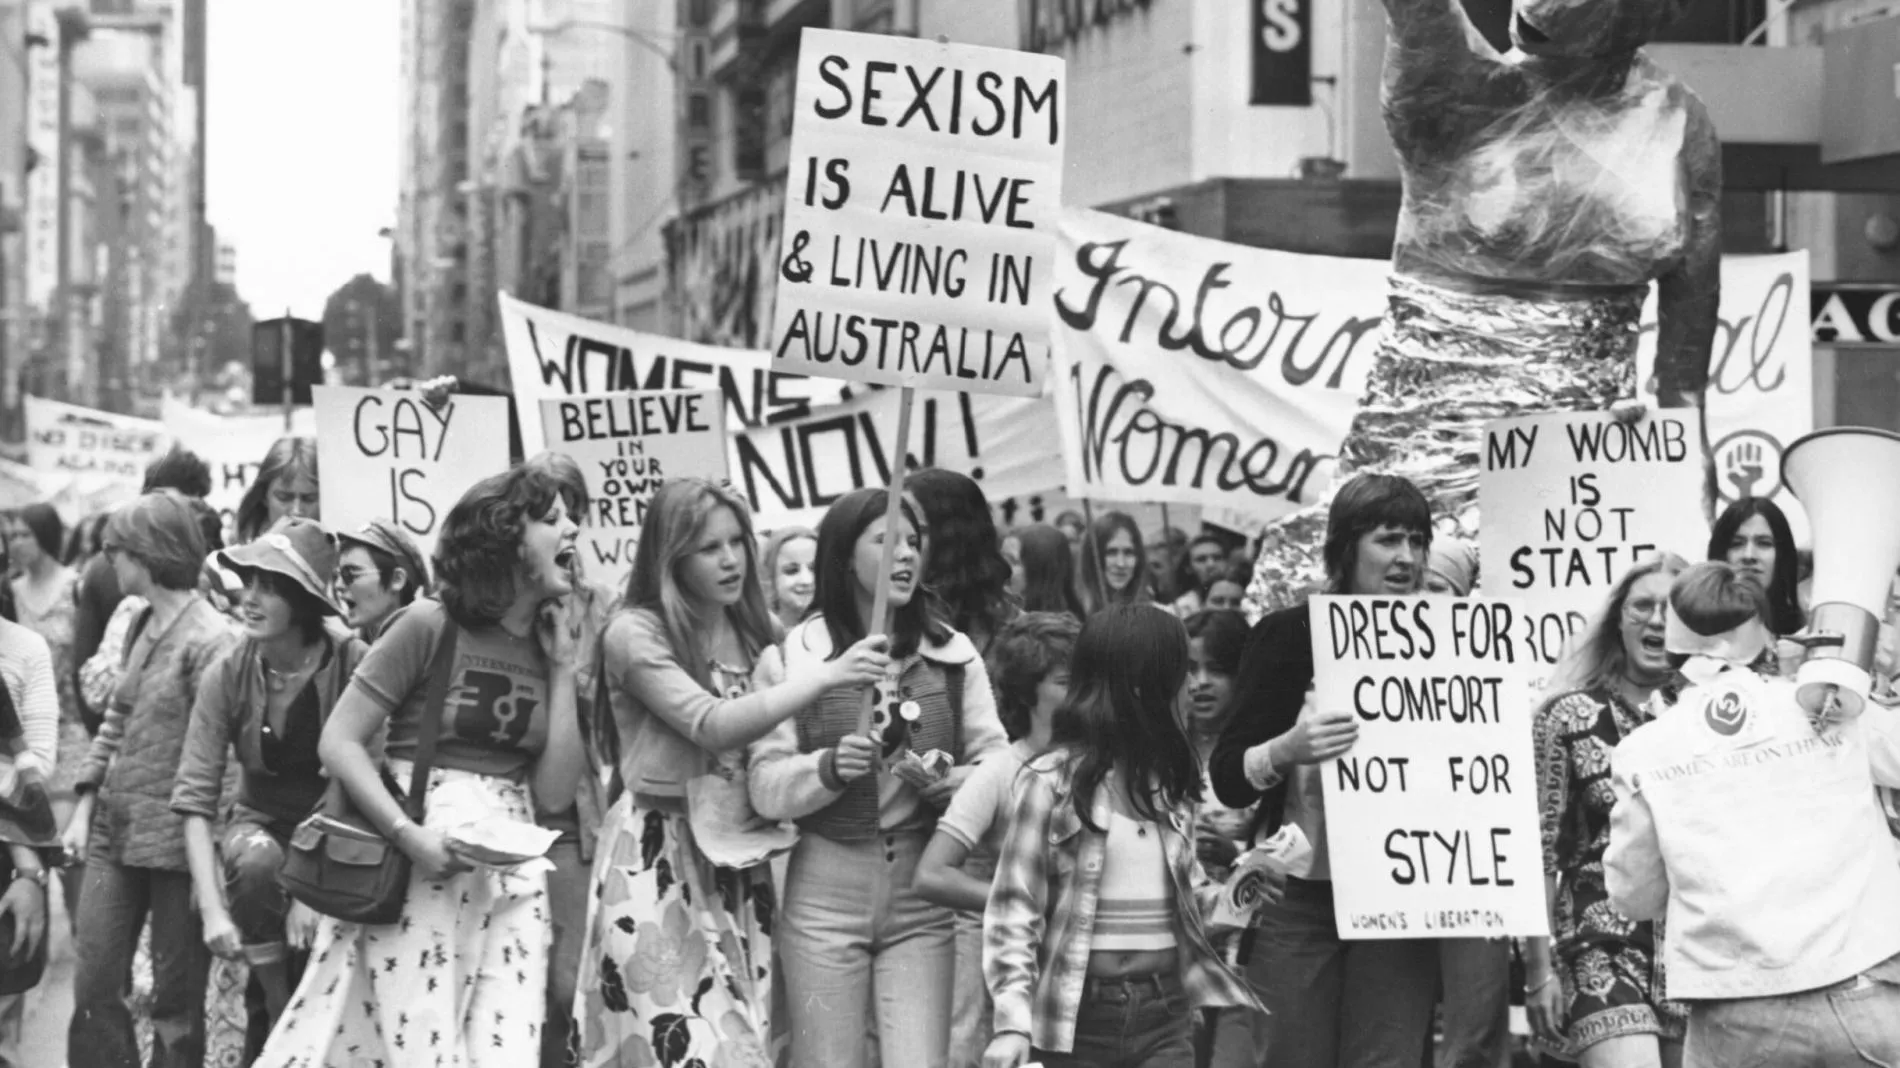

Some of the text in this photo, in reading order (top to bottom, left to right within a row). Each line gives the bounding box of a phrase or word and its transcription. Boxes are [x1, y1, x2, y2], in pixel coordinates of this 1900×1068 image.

[1262, 0, 1300, 51] S
[814, 55, 1057, 145] SEXISM
[805, 157, 1035, 229] IS ALIVE
[782, 230, 1032, 305] & LIVING IN
[776, 308, 1031, 383] AUSTRALIA
[354, 396, 455, 461] GAY
[560, 395, 710, 441] BELIEVE
[598, 457, 663, 478] YOUR
[618, 440, 643, 456] IN
[1487, 419, 1687, 471] MY WOMB
[390, 467, 436, 535] IS
[603, 479, 664, 496] OWN
[1570, 474, 1600, 505] IS
[1545, 508, 1635, 541] NOT
[1329, 600, 1514, 663] DRESS FOR
[1354, 675, 1503, 723] COMFORT
[1336, 754, 1511, 794] NOT FOR
[1385, 828, 1514, 886] STYLE
[1351, 909, 1504, 930] WOMEN'S LIBERATION
